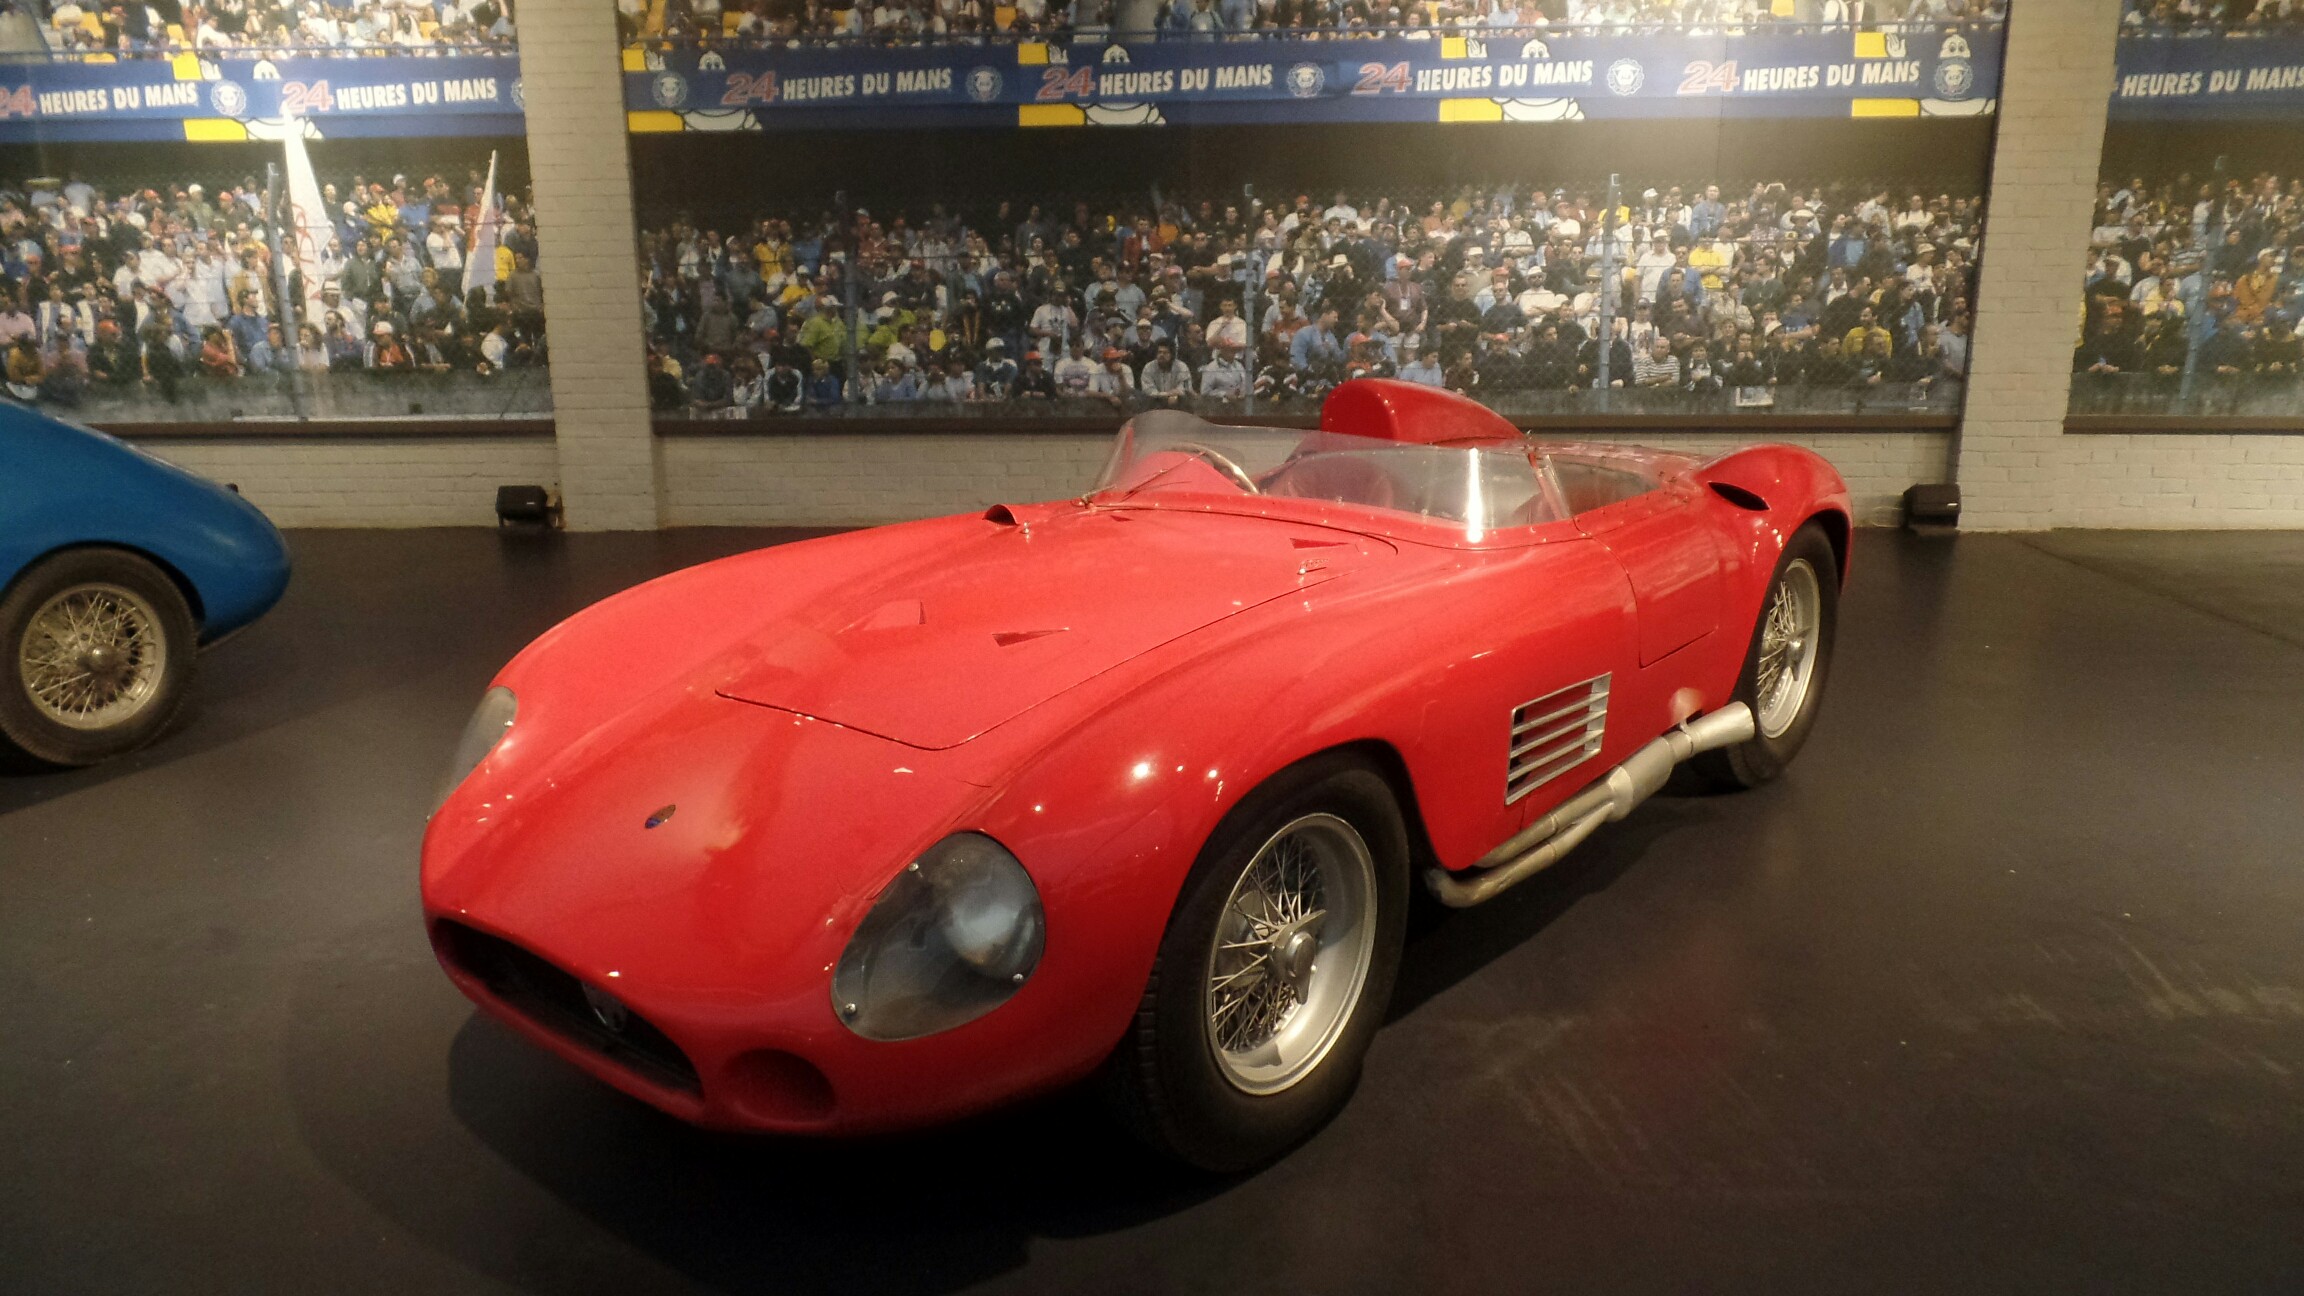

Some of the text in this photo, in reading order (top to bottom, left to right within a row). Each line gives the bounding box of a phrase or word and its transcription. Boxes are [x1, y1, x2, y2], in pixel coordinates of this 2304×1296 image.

[721, 70, 779, 105] 24
[783, 75, 855, 100] HEURES
[862, 72, 889, 95] DU
[896, 68, 952, 92] MANS
[1035, 65, 1096, 100] 24
[1099, 70, 1173, 96] HEURES
[1180, 68, 1209, 91] DU
[1215, 64, 1273, 88] MANS
[1351, 61, 1412, 94] 24
[1416, 65, 1493, 92] HEURES
[1499, 63, 1528, 87] DU
[1533, 60, 1593, 85] MANS
[1677, 60, 1740, 95] 24
[1743, 65, 1820, 91] HEURES
[1826, 64, 1855, 87] DU
[1861, 61, 1920, 85] MANS
[2121, 71, 2203, 97] HEURES
[2208, 69, 2241, 93] DU
[39, 88, 108, 115] HEURES
[113, 87, 140, 110] DU
[145, 82, 199, 107] MANS
[280, 77, 497, 114] 24 HEURES DU MANS
